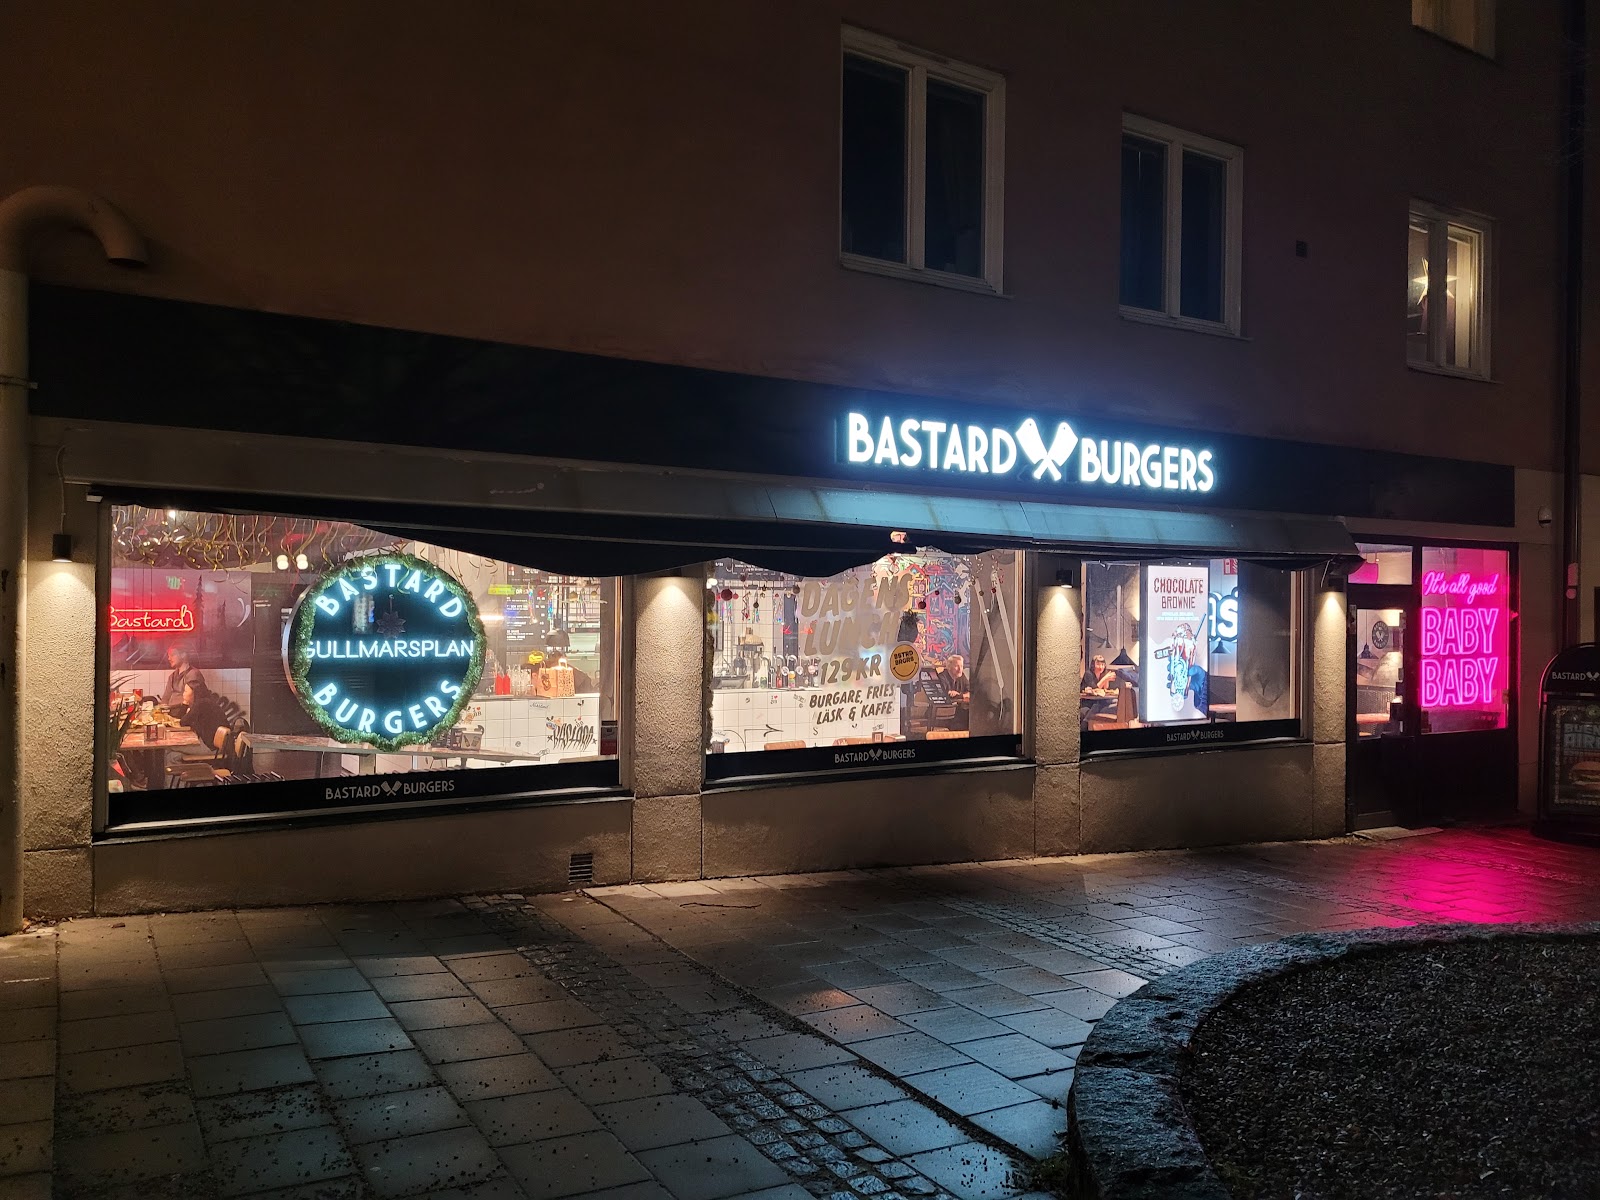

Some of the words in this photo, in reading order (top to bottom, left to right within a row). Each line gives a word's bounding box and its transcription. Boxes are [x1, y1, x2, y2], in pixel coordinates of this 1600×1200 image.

[848, 412, 1017, 475] BASTARD
[1080, 437, 1214, 492] BURGERS
[314, 564, 462, 618] BASTARD
[801, 573, 914, 618] DAGENS
[1153, 578, 1204, 594] CHOCOLATE
[1424, 572, 1448, 595] It's
[1449, 573, 1470, 594] all
[1469, 574, 1499, 604] good
[1161, 596, 1196, 609] BROWNIE
[803, 611, 900, 656] LUNCH
[1421, 608, 1499, 656] BABY
[307, 640, 474, 659] GULLMARSPLAN
[820, 658, 853, 685] 129
[856, 654, 882, 681] KR
[1421, 657, 1498, 707] BABY
[1552, 671, 1587, 681] BASTARD
[313, 680, 461, 734] BURGERS
[809, 689, 863, 709] BURGARE,
[867, 683, 895, 699] FRIES
[817, 709, 844, 725] LÄSK
[848, 706, 857, 721] &
[861, 701, 893, 718] KAFFE
[1166, 732, 1191, 742] BASTARD
[1200, 730, 1224, 740] BURGERS
[1564, 734, 1600, 750] AIR
[834, 751, 869, 763] BASTARD
[882, 748, 916, 760] BURGERS
[325, 785, 381, 800] BASTARD
[403, 779, 455, 795] BURGERS
